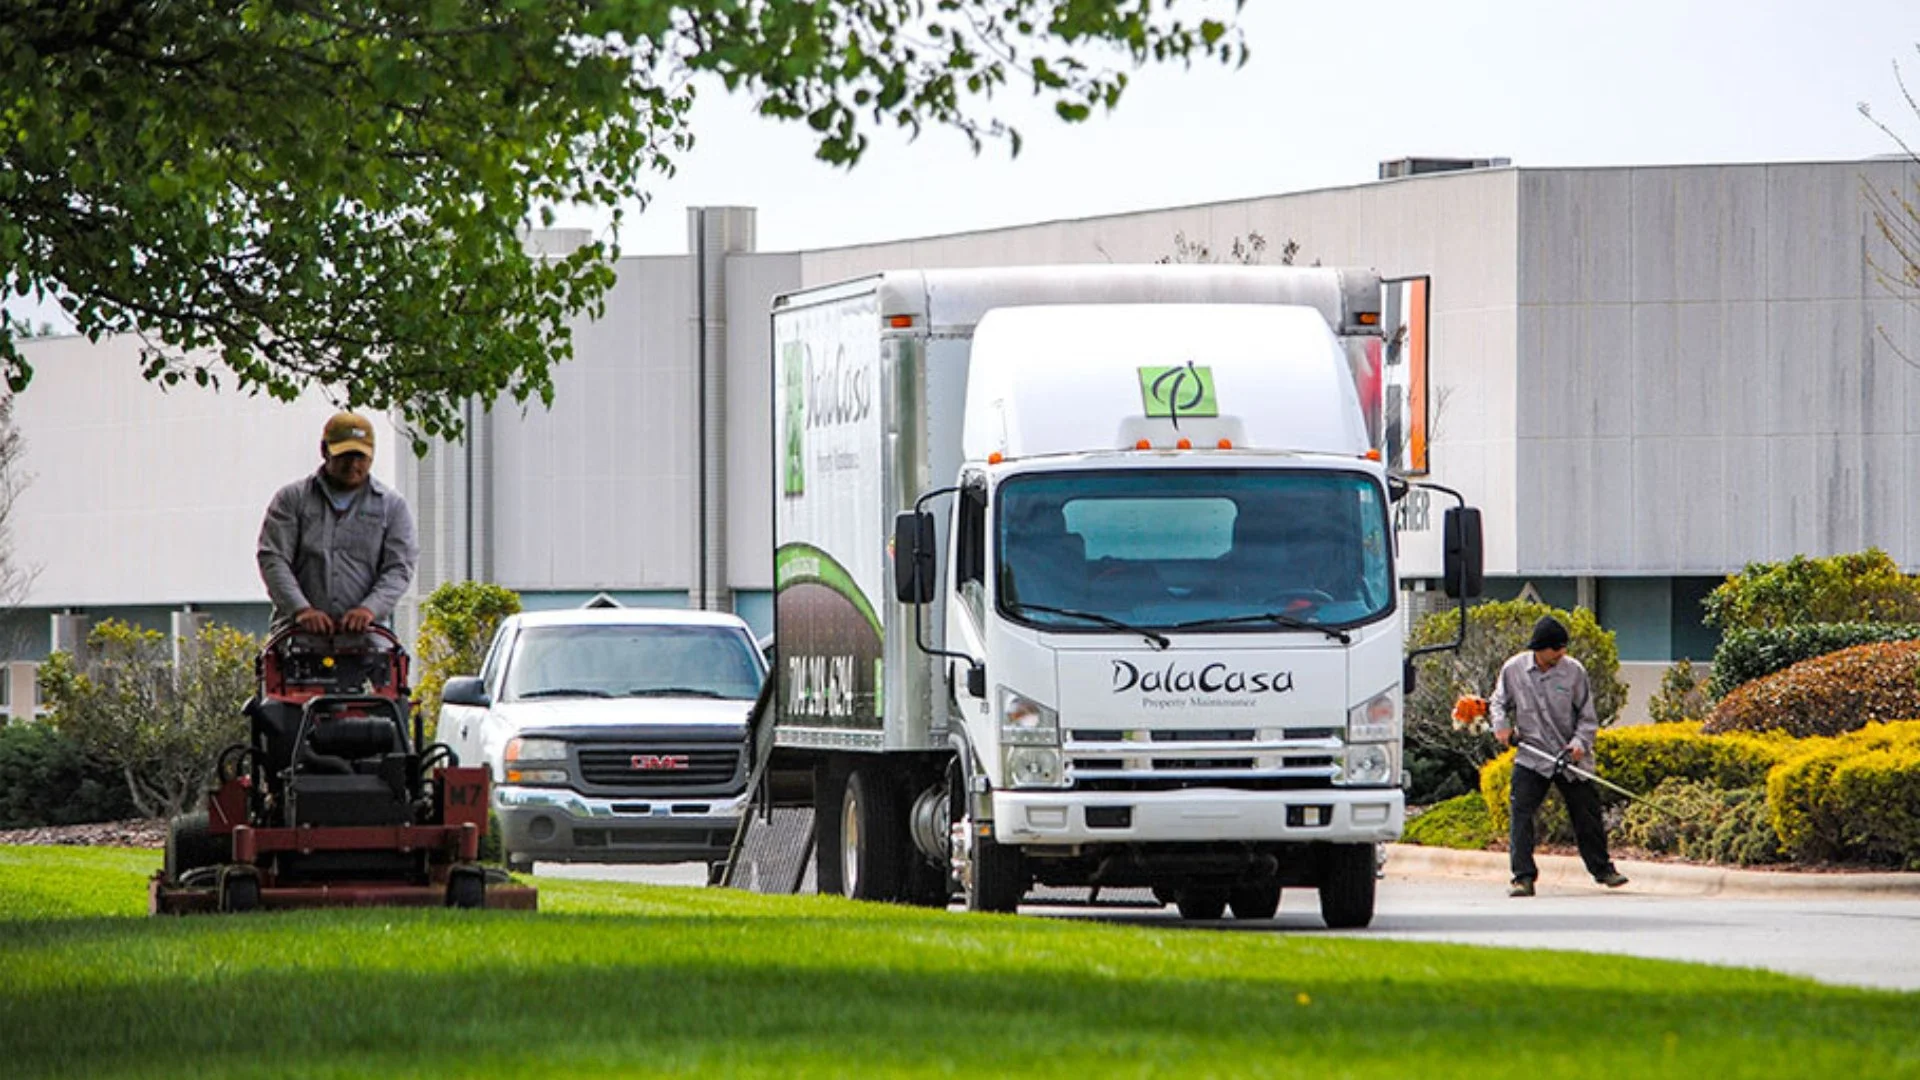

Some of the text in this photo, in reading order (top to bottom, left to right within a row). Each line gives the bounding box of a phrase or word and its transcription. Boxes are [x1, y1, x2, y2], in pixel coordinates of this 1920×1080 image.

[1111, 659, 1295, 694] DalaCasa
[630, 755, 689, 769] GMC
[450, 783, 482, 806] M7
